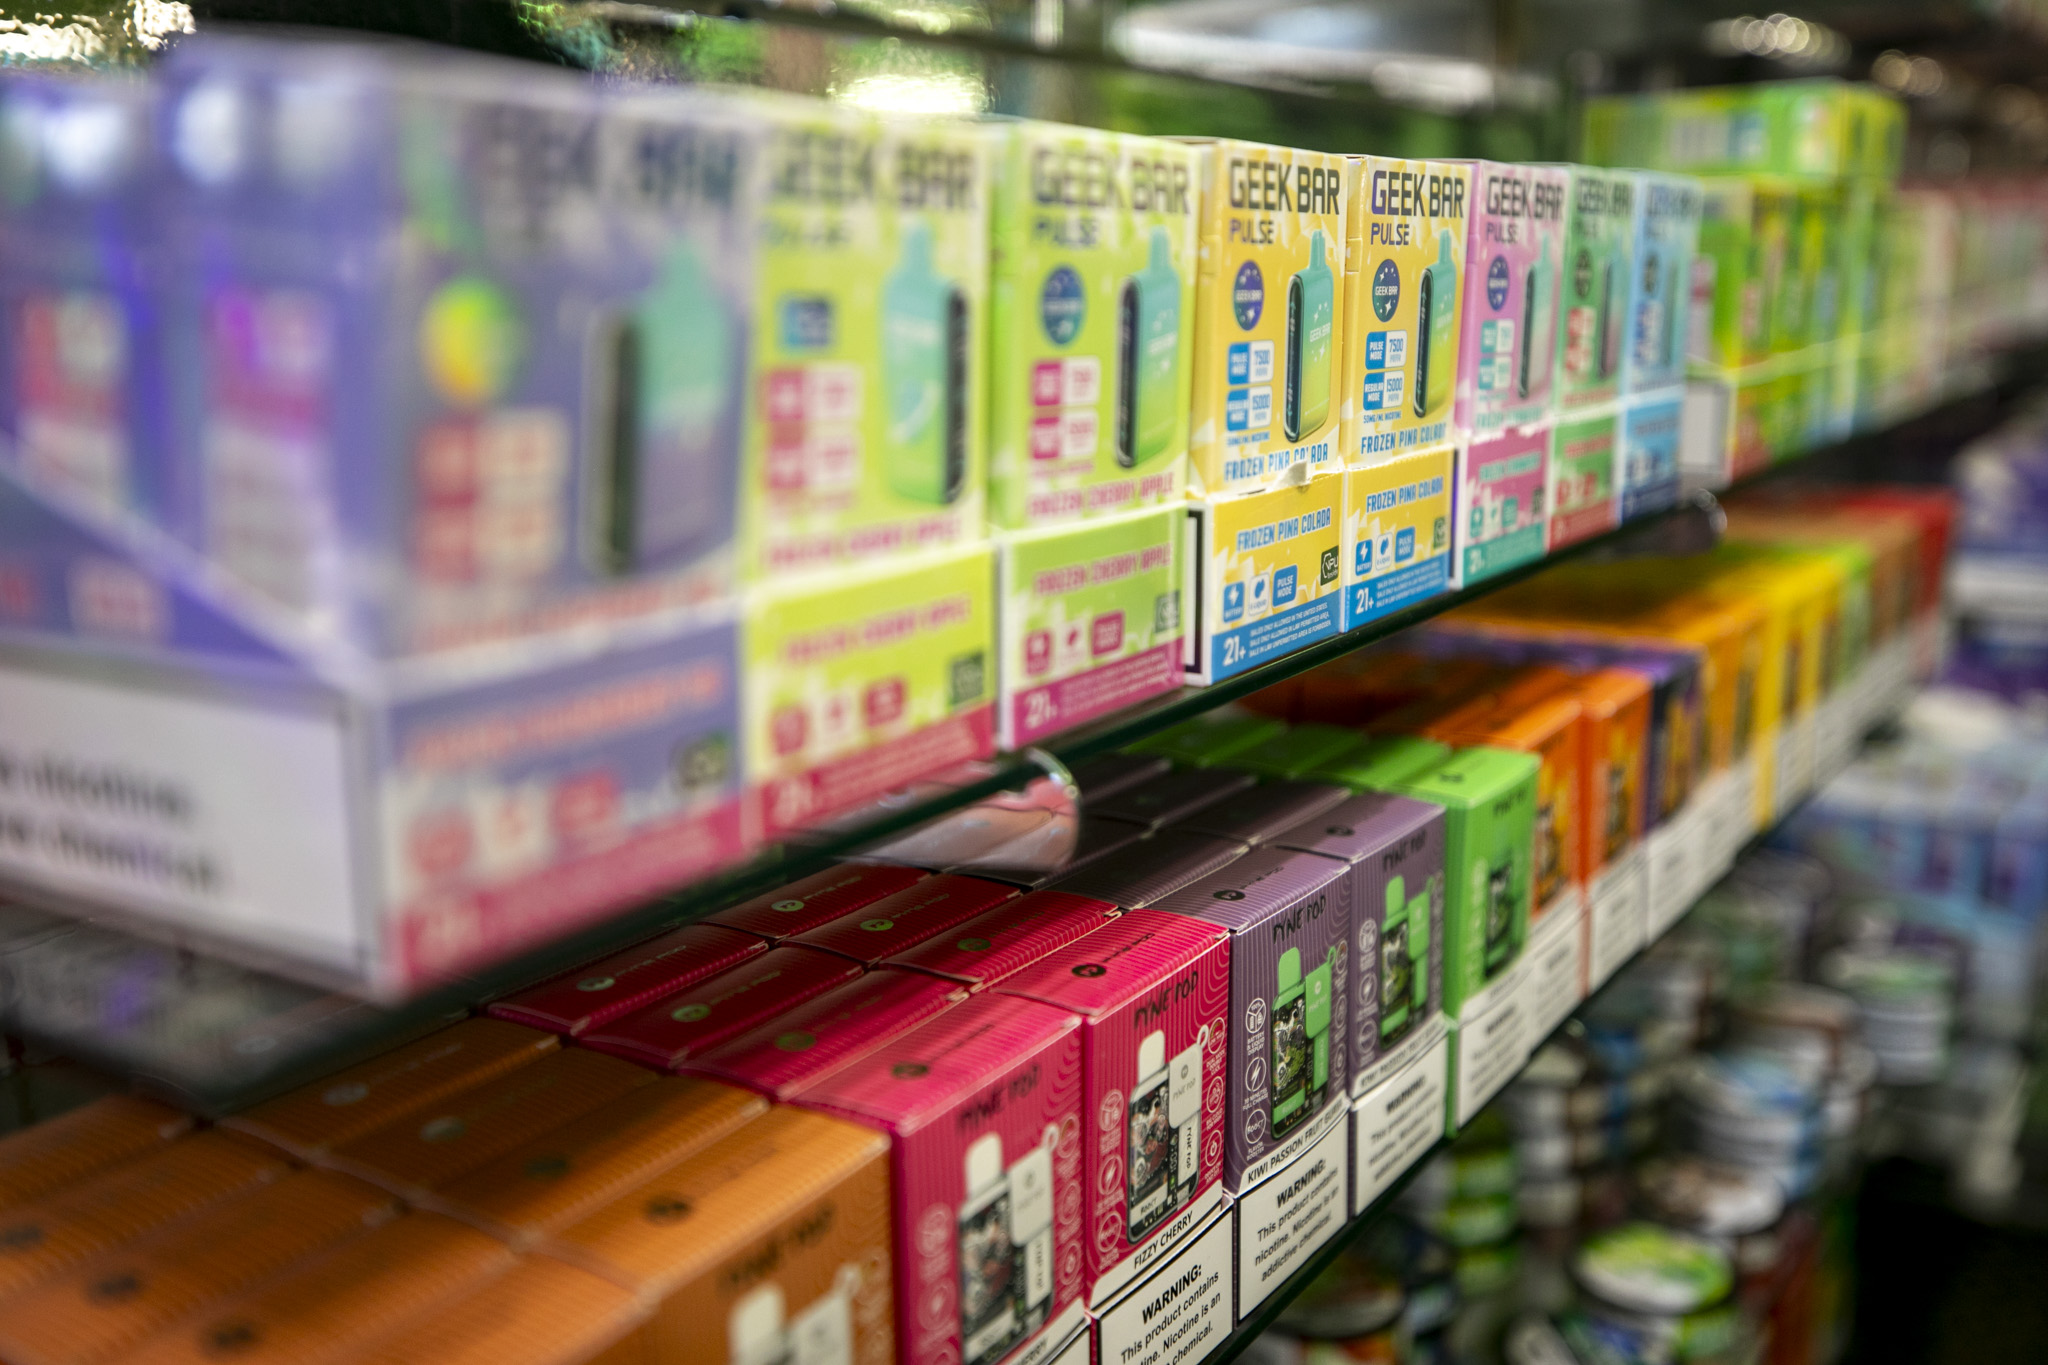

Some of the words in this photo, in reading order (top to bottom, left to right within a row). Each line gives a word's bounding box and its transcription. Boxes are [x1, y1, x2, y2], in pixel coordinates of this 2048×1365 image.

[1132, 159, 1190, 215] BAR
[1230, 159, 1292, 212] GEEK
[1297, 165, 1340, 215] BAR
[1371, 170, 1426, 217] GEEK
[1429, 175, 1464, 218] BAR
[1487, 176, 1532, 218] GEEK
[1533, 182, 1564, 220] BAR
[1230, 218, 1274, 244] PULSE
[1371, 222, 1410, 246] PULSE
[1375, 286, 1388, 296] GEEK
[1388, 285, 1399, 295] BAR
[1389, 339, 1404, 352] 7500
[1361, 431, 1396, 455] FROZEN
[1399, 426, 1418, 448] PINA
[1224, 457, 1265, 483] FROZEN
[1268, 450, 1290, 473] PINA
[1366, 489, 1397, 513] FROZEN
[1399, 483, 1417, 505] PINA
[1418, 476, 1444, 498] COLADA
[1236, 523, 1275, 552] FROZEN
[1278, 517, 1299, 542] PINA
[1301, 507, 1331, 534] COLADA
[1277, 575, 1294, 588] PULSE
[1277, 586, 1292, 599] MODE
[1355, 587, 1374, 615] 21+
[1222, 635, 1246, 666] 21+
[1248, 1161, 1269, 1184] KIWI
[1270, 1136, 1304, 1169] PASSION
[1276, 1159, 1327, 1208] WARNING:
[1133, 1240, 1159, 1269] FIZZY
[1160, 1211, 1193, 1246] CHERRY
[1257, 1222, 1276, 1242] This
[1278, 1194, 1310, 1231] product
[1261, 1244, 1298, 1282] addictive
[1142, 1264, 1202, 1325] WARNING:
[1120, 1340, 1143, 1364] This
[1145, 1307, 1182, 1349] product
[1183, 1271, 1219, 1311] contains
[1163, 1313, 1200, 1353] Nicotine
[1201, 1303, 1209, 1318] is
[1210, 1292, 1221, 1310] an
[1172, 1320, 1214, 1365] chemical.
